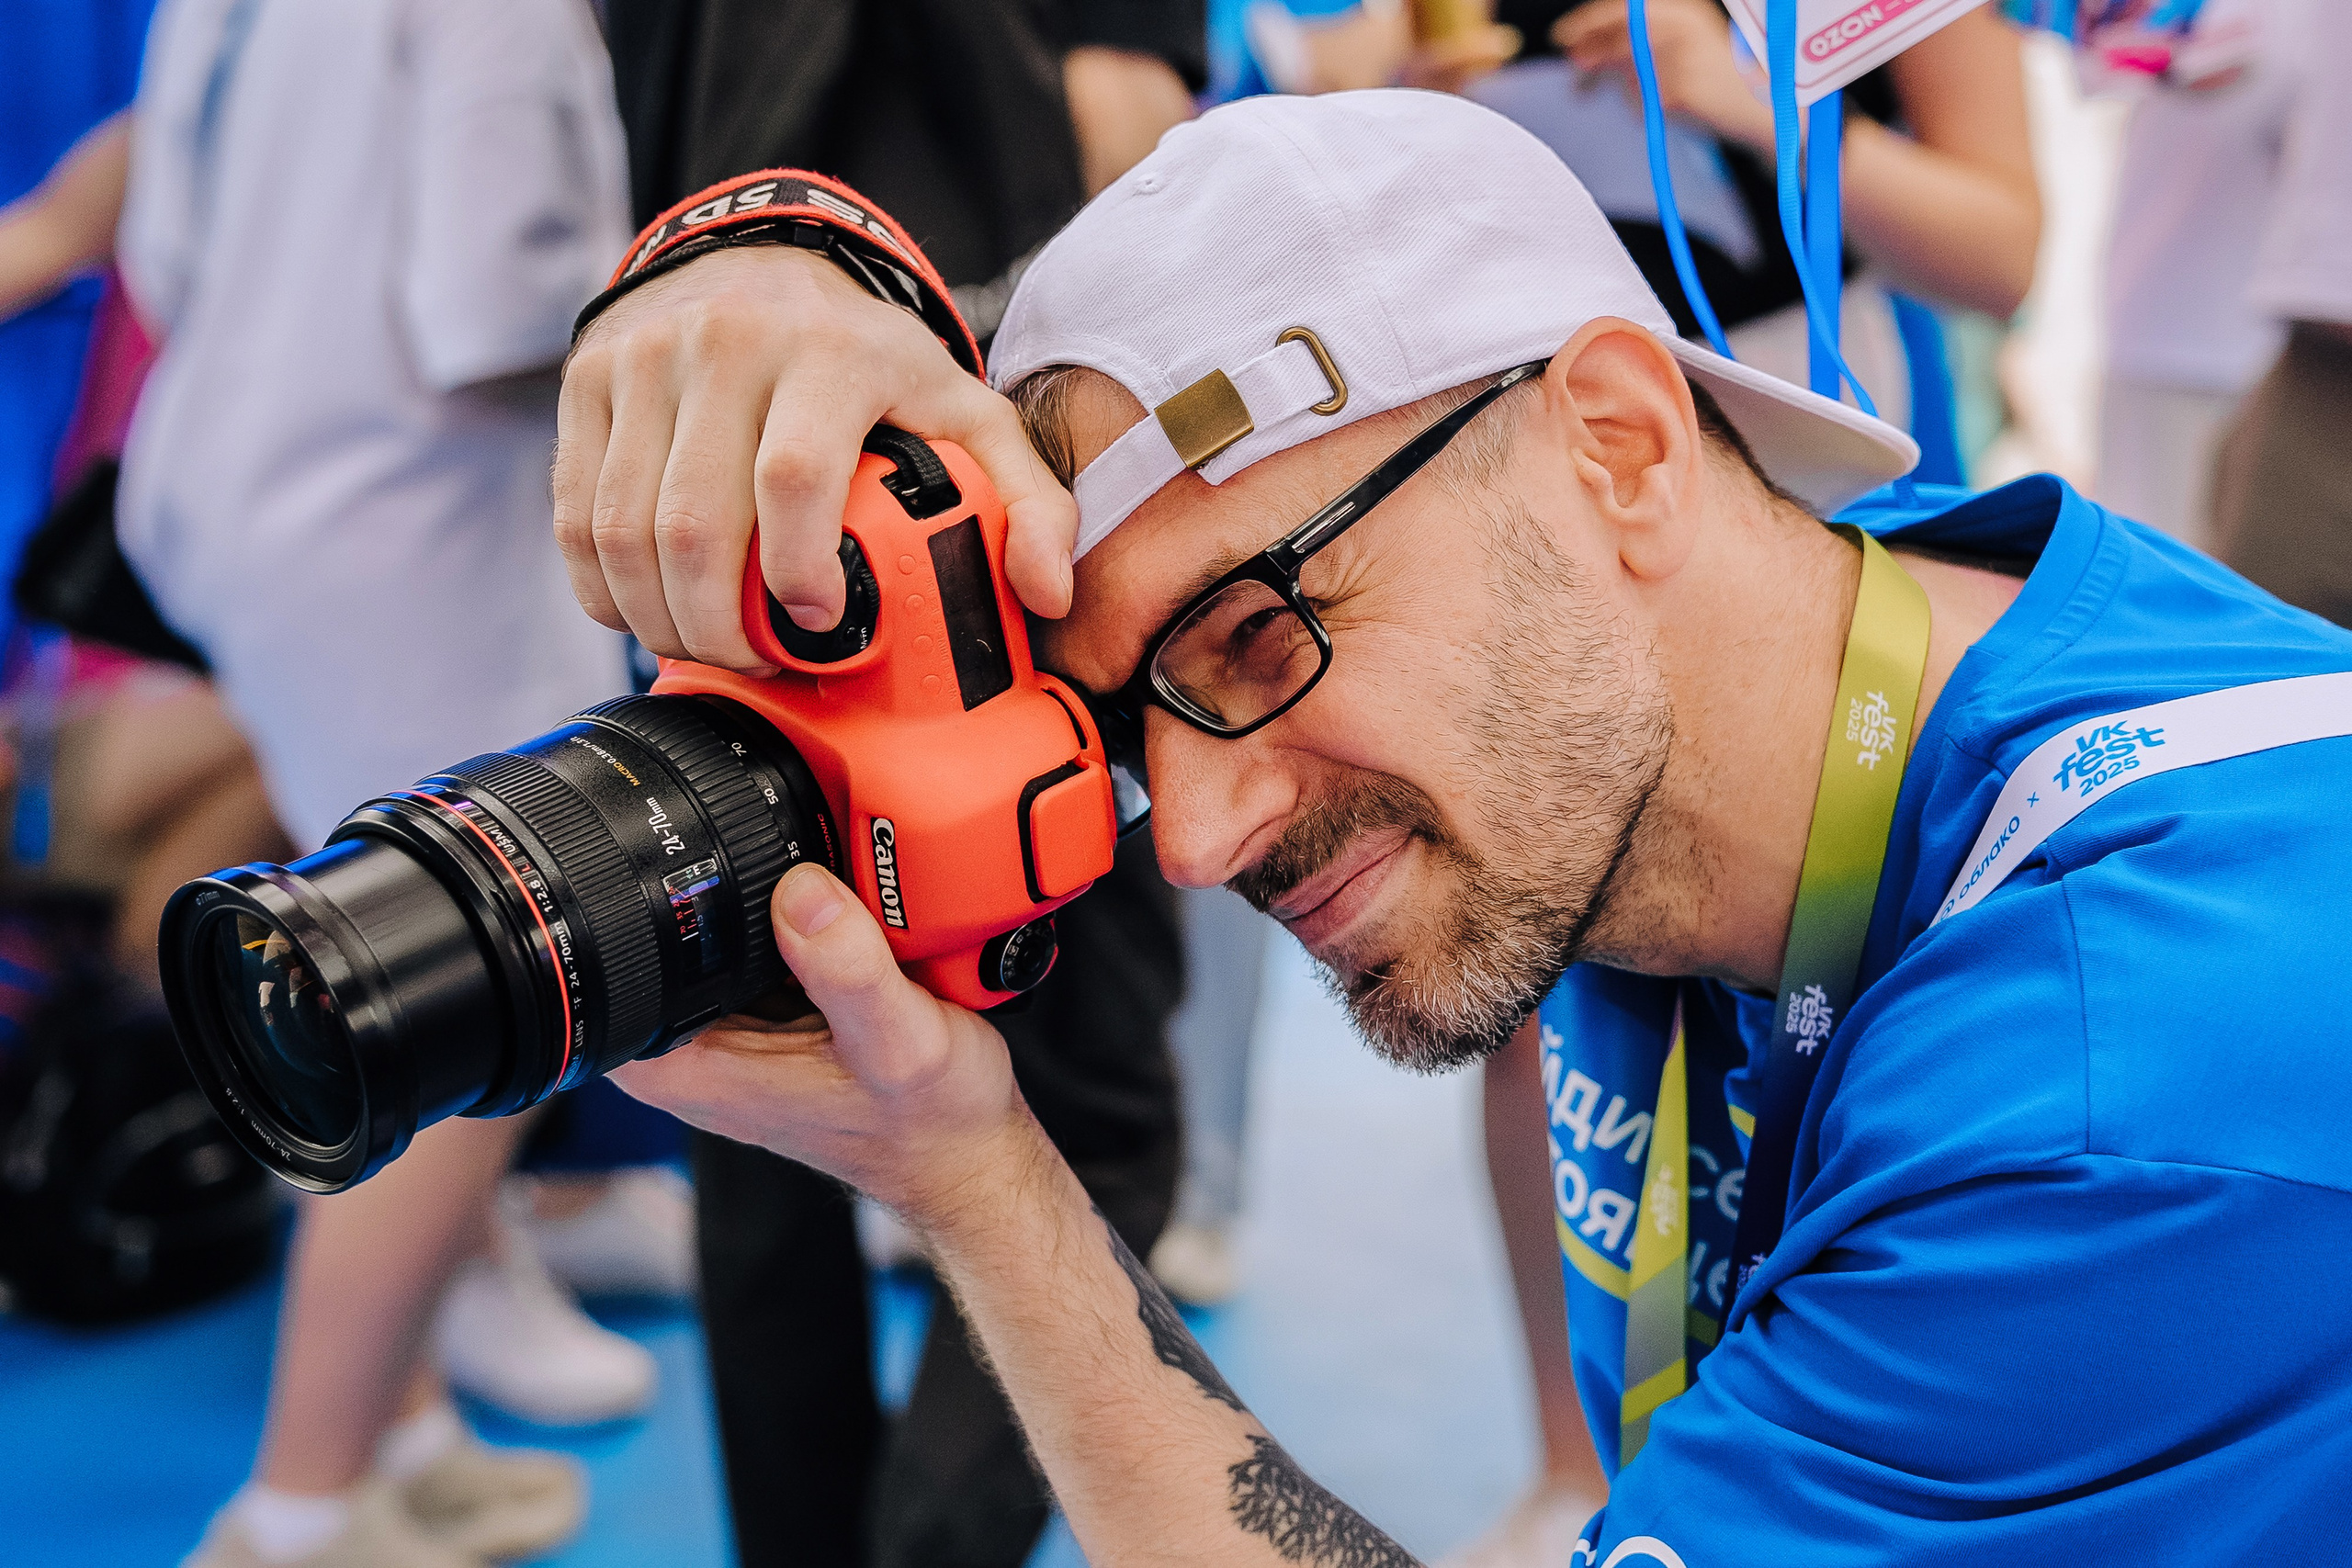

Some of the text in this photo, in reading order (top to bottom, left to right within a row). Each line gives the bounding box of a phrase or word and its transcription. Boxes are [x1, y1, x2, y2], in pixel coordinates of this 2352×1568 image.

[1808, 4, 1884, 58] OZON
[681, 182, 778, 227] 5D
[1846, 696, 1863, 742] 2025
[1857, 691, 1890, 771] fest
[1879, 716, 1897, 754] VK
[2075, 719, 2132, 754] VK
[731, 741, 748, 757] 70
[2052, 727, 2166, 793] fest
[613, 761, 641, 787] MACRO
[2079, 754, 2141, 798] 2025
[763, 787, 779, 806] 50
[490, 829, 516, 853] USM
[646, 796, 685, 855] 24-70mm
[817, 813, 836, 874] TRASONIC
[787, 840, 800, 860] 35
[1959, 816, 2020, 900] облако
[873, 817, 905, 927] Canon
[529, 879, 553, 912] 1:2.8
[553, 920, 581, 988] 24-70mm
[1785, 991, 1802, 1033] 2025
[1795, 984, 1826, 1056] fest
[1815, 1006, 1833, 1039] VK
[574, 1020, 584, 1048] LENS
[250, 1120, 291, 1162] 24-70mm
